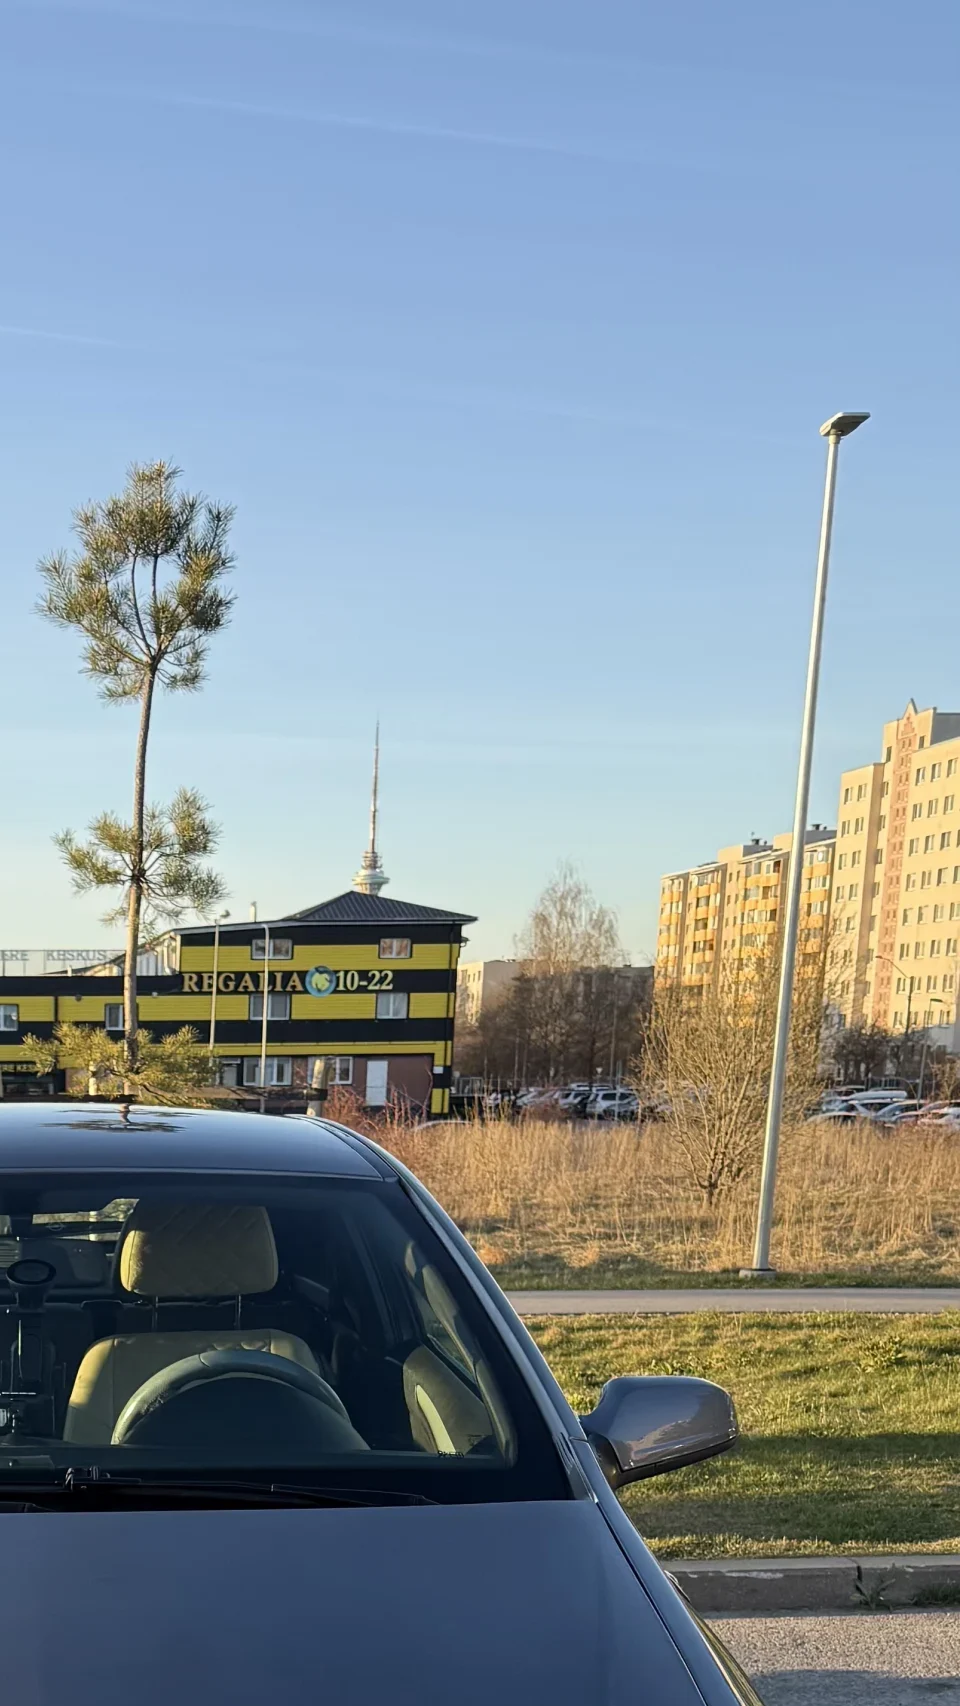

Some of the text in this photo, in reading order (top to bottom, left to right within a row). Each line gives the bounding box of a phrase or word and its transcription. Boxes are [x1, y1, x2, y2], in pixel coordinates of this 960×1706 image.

[47, 949, 107, 961] KESKUS
[181, 970, 394, 992] REGALIA 10-22
